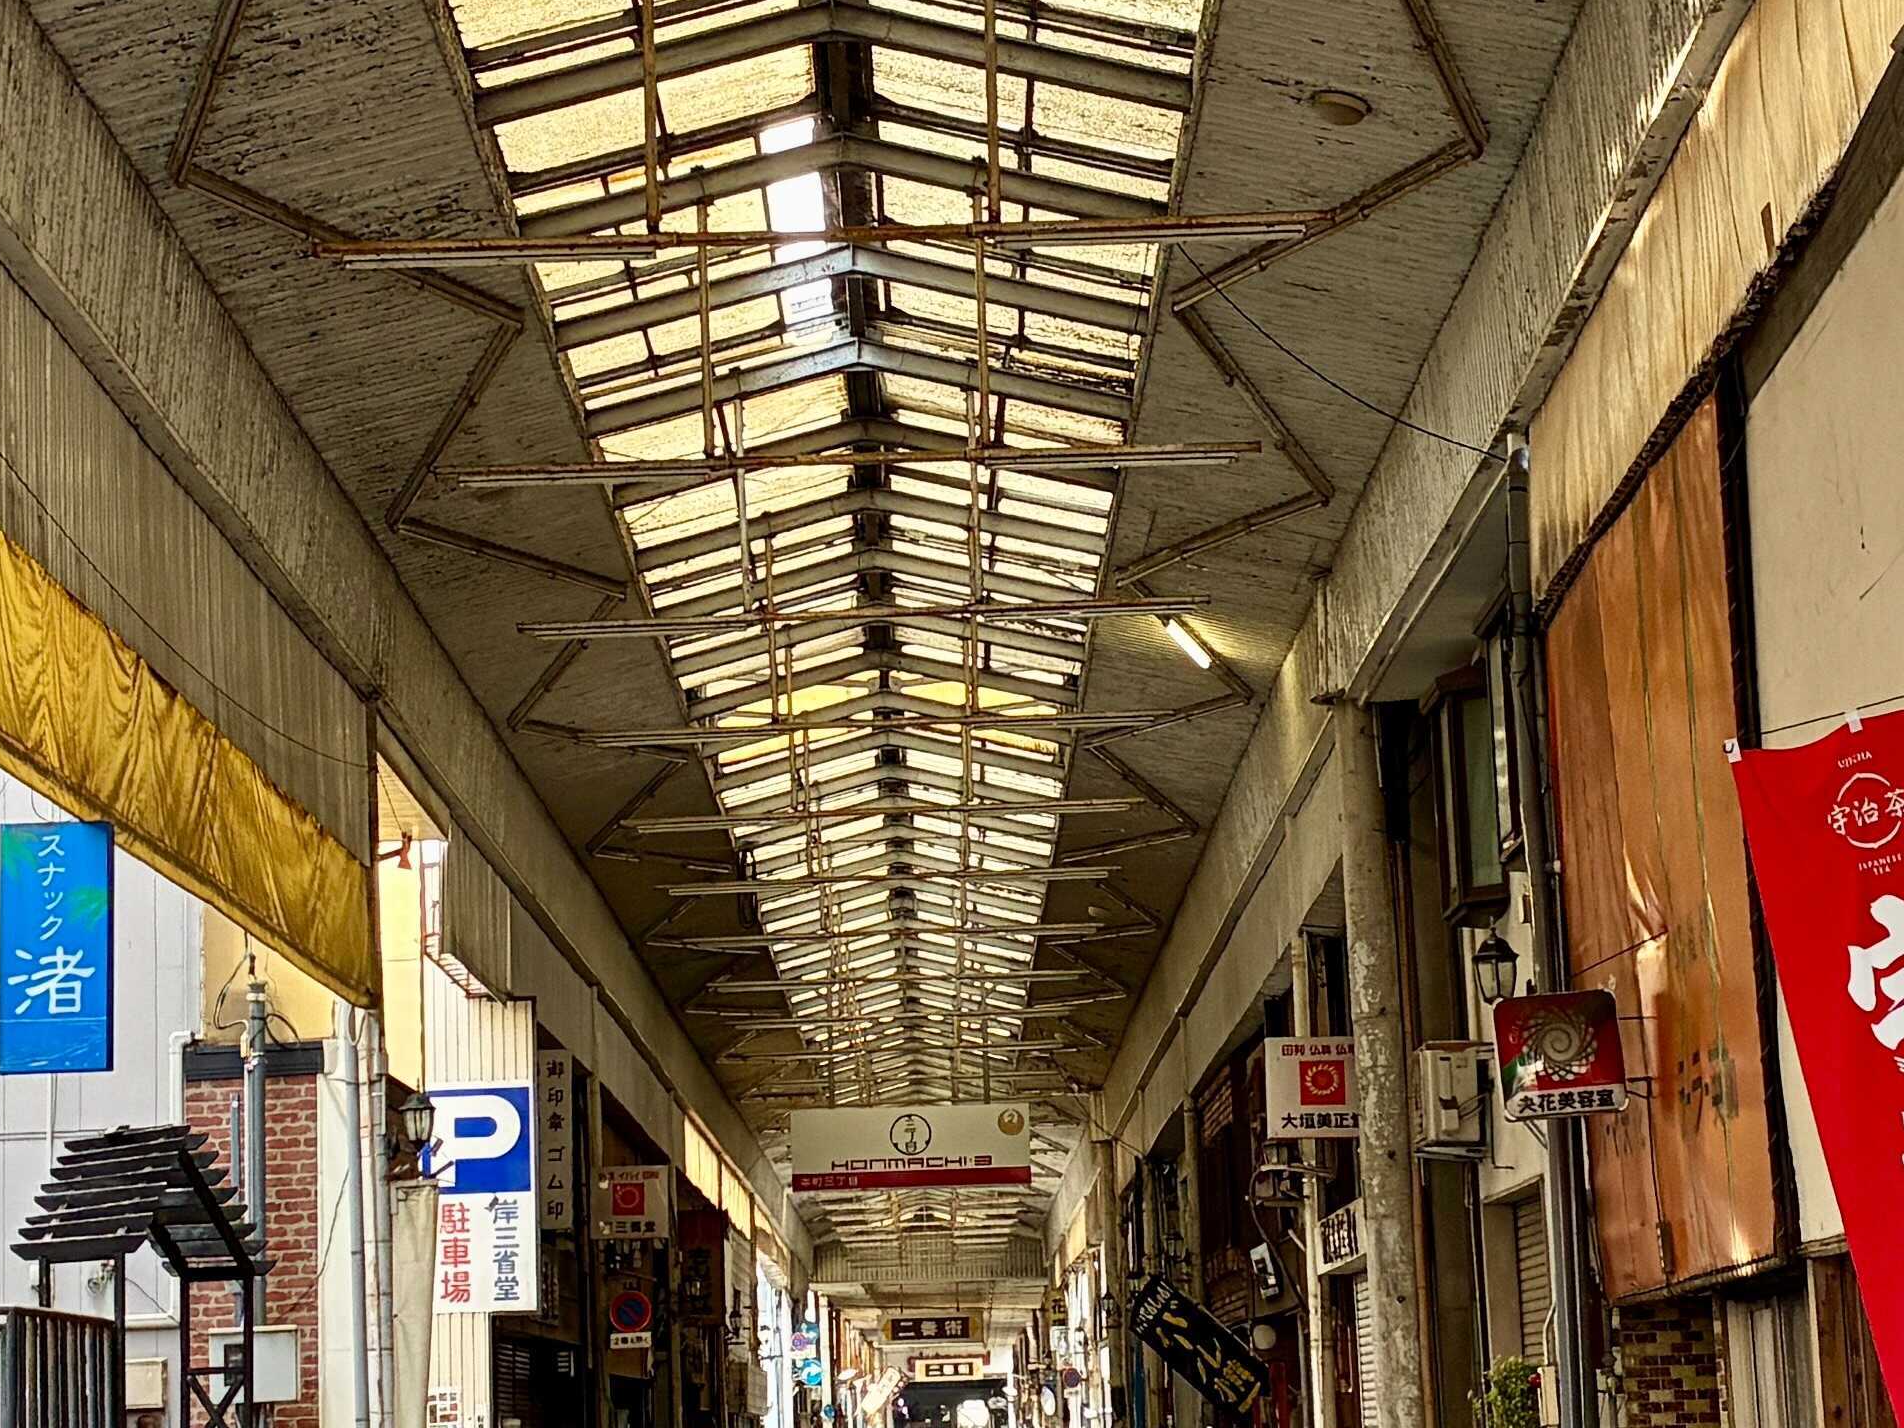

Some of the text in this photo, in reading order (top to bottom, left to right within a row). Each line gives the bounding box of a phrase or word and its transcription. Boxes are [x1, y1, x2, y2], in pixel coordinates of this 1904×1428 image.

[37, 834, 66, 941] スナック
[7, 945, 96, 1016] 渚
[430, 1094, 522, 1188] P
[439, 1201, 472, 1304] 駐車場
[490, 1197, 521, 1302] 岸三省堂
